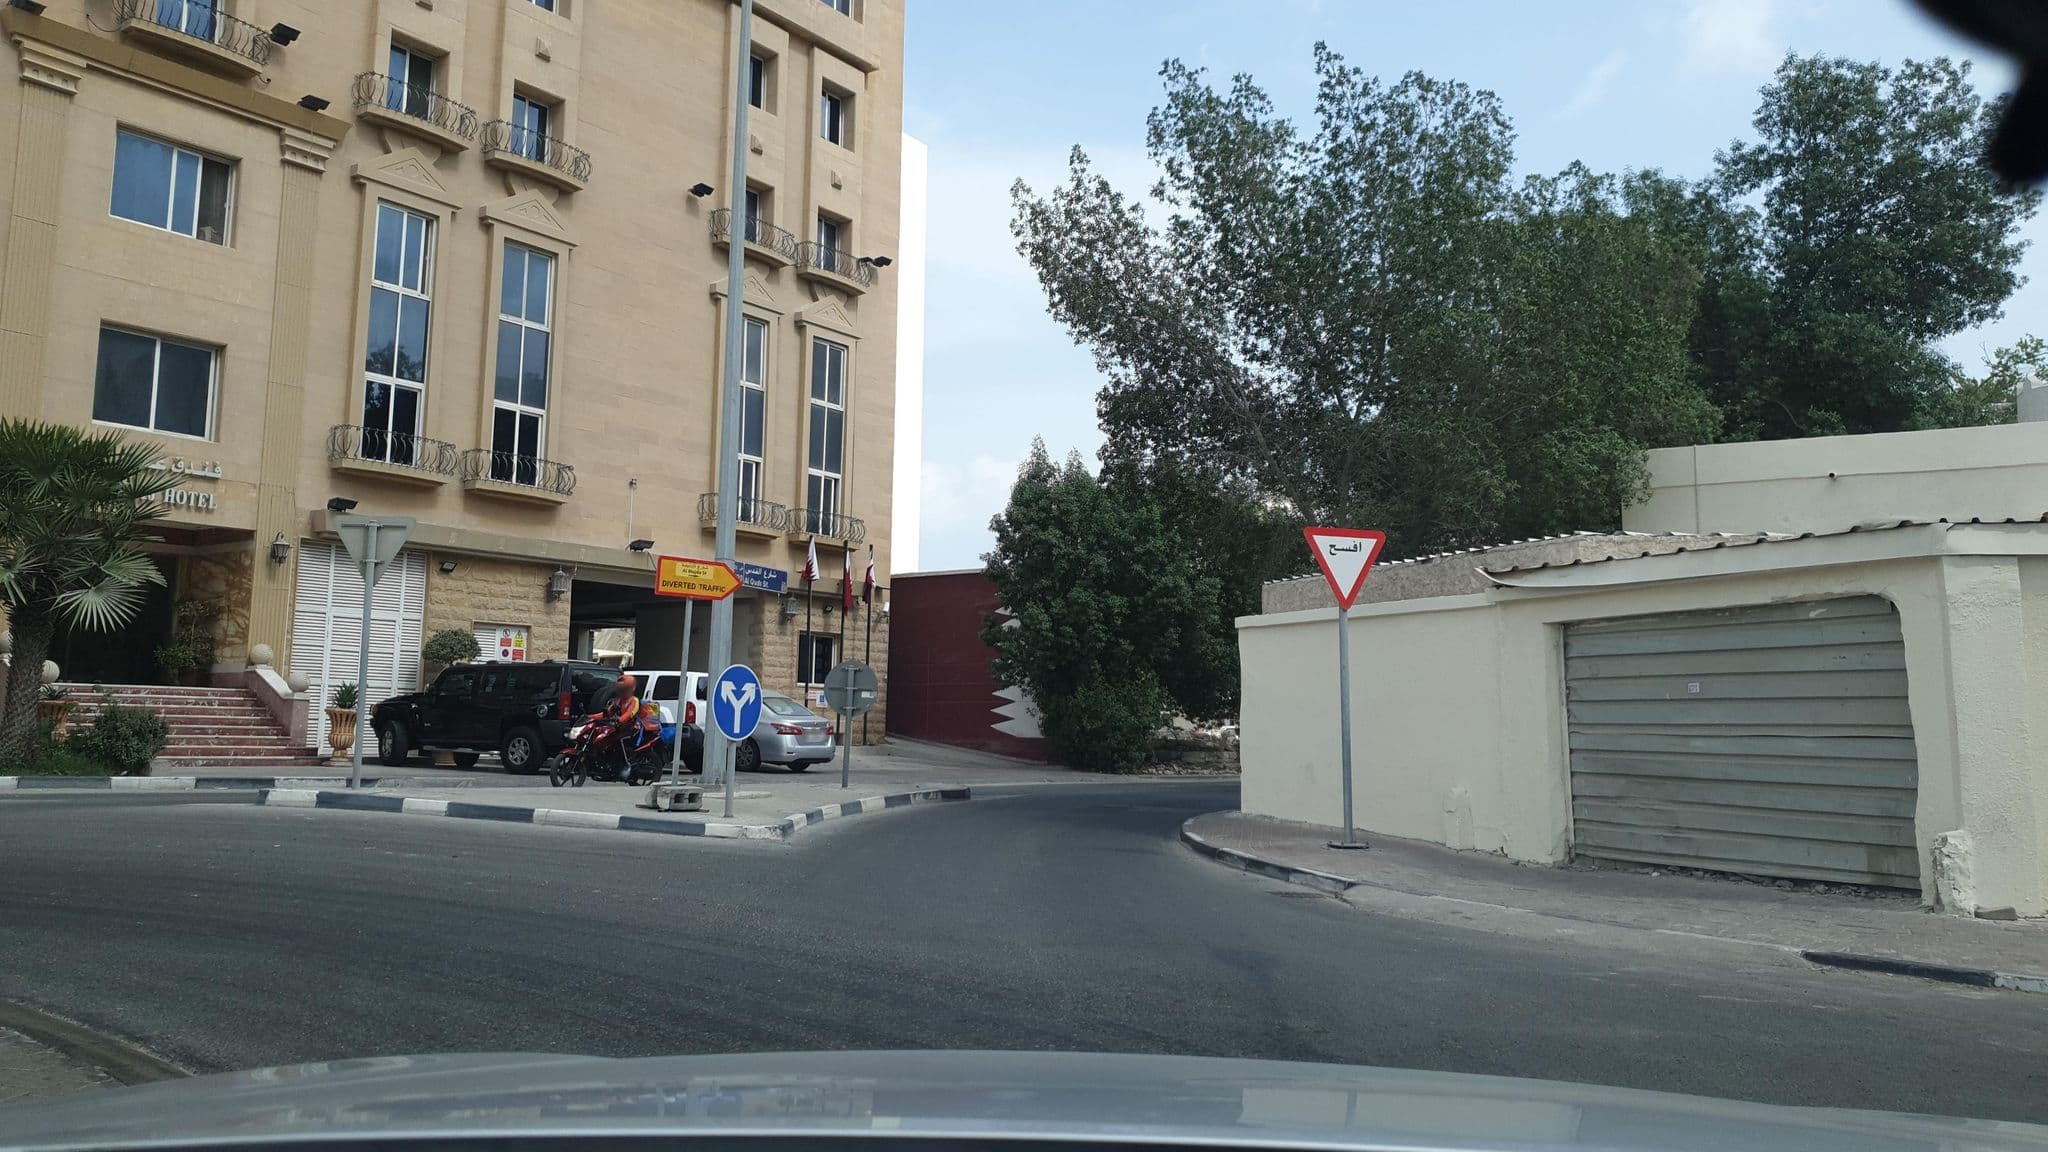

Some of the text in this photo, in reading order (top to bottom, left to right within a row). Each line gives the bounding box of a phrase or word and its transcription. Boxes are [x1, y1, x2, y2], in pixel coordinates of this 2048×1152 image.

[171, 456, 222, 478] فندق
[164, 488, 217, 509] HOTEL
[1329, 540, 1362, 556] افسح
[763, 569, 777, 579] شارع
[662, 579, 726, 593] DIVERTED TRAFFIC
